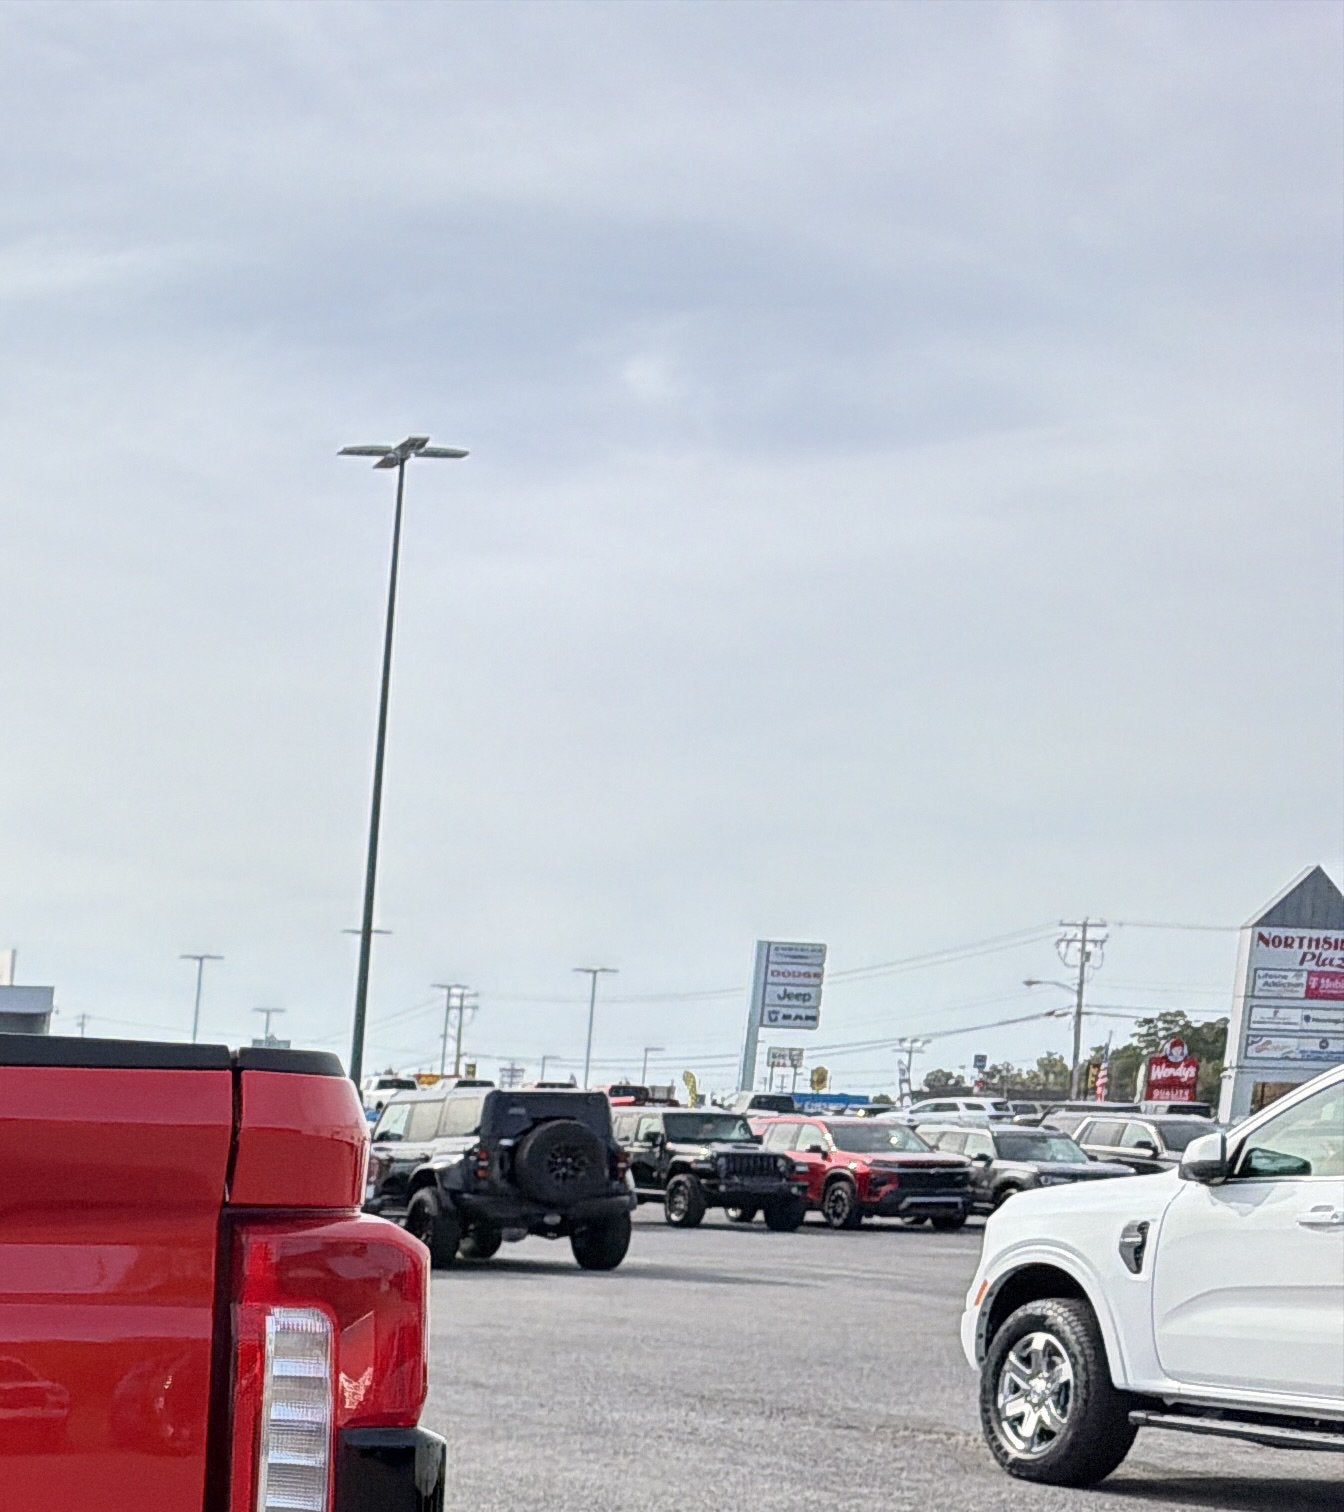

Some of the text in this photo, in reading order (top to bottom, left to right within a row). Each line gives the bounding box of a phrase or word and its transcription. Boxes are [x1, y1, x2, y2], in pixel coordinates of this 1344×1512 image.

[771, 969, 822, 979] DODGE
[777, 987, 812, 1003] Jeep
[781, 1013, 817, 1021] RAM
[1151, 1062, 1197, 1082] Wendy's
